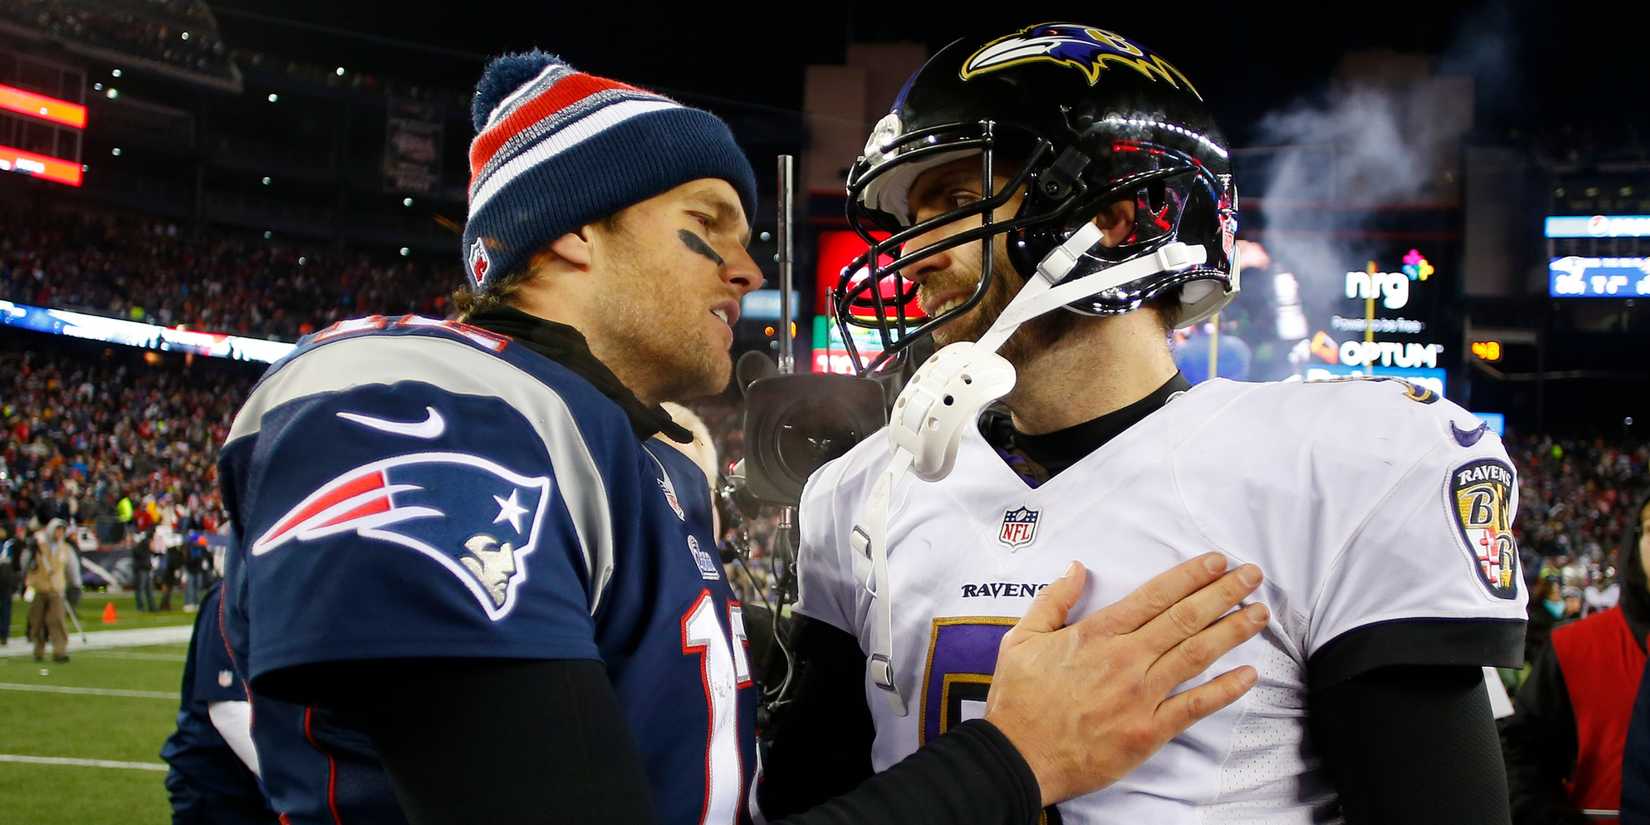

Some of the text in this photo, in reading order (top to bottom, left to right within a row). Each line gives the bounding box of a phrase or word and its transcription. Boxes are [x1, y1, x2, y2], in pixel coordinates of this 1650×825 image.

[1345, 271, 1409, 309] nrg
[1339, 340, 1438, 369] OPTUM
[1457, 465, 1512, 487] RAVENS
[1002, 523, 1031, 543] NFL
[961, 582, 1049, 599] RAVEN
